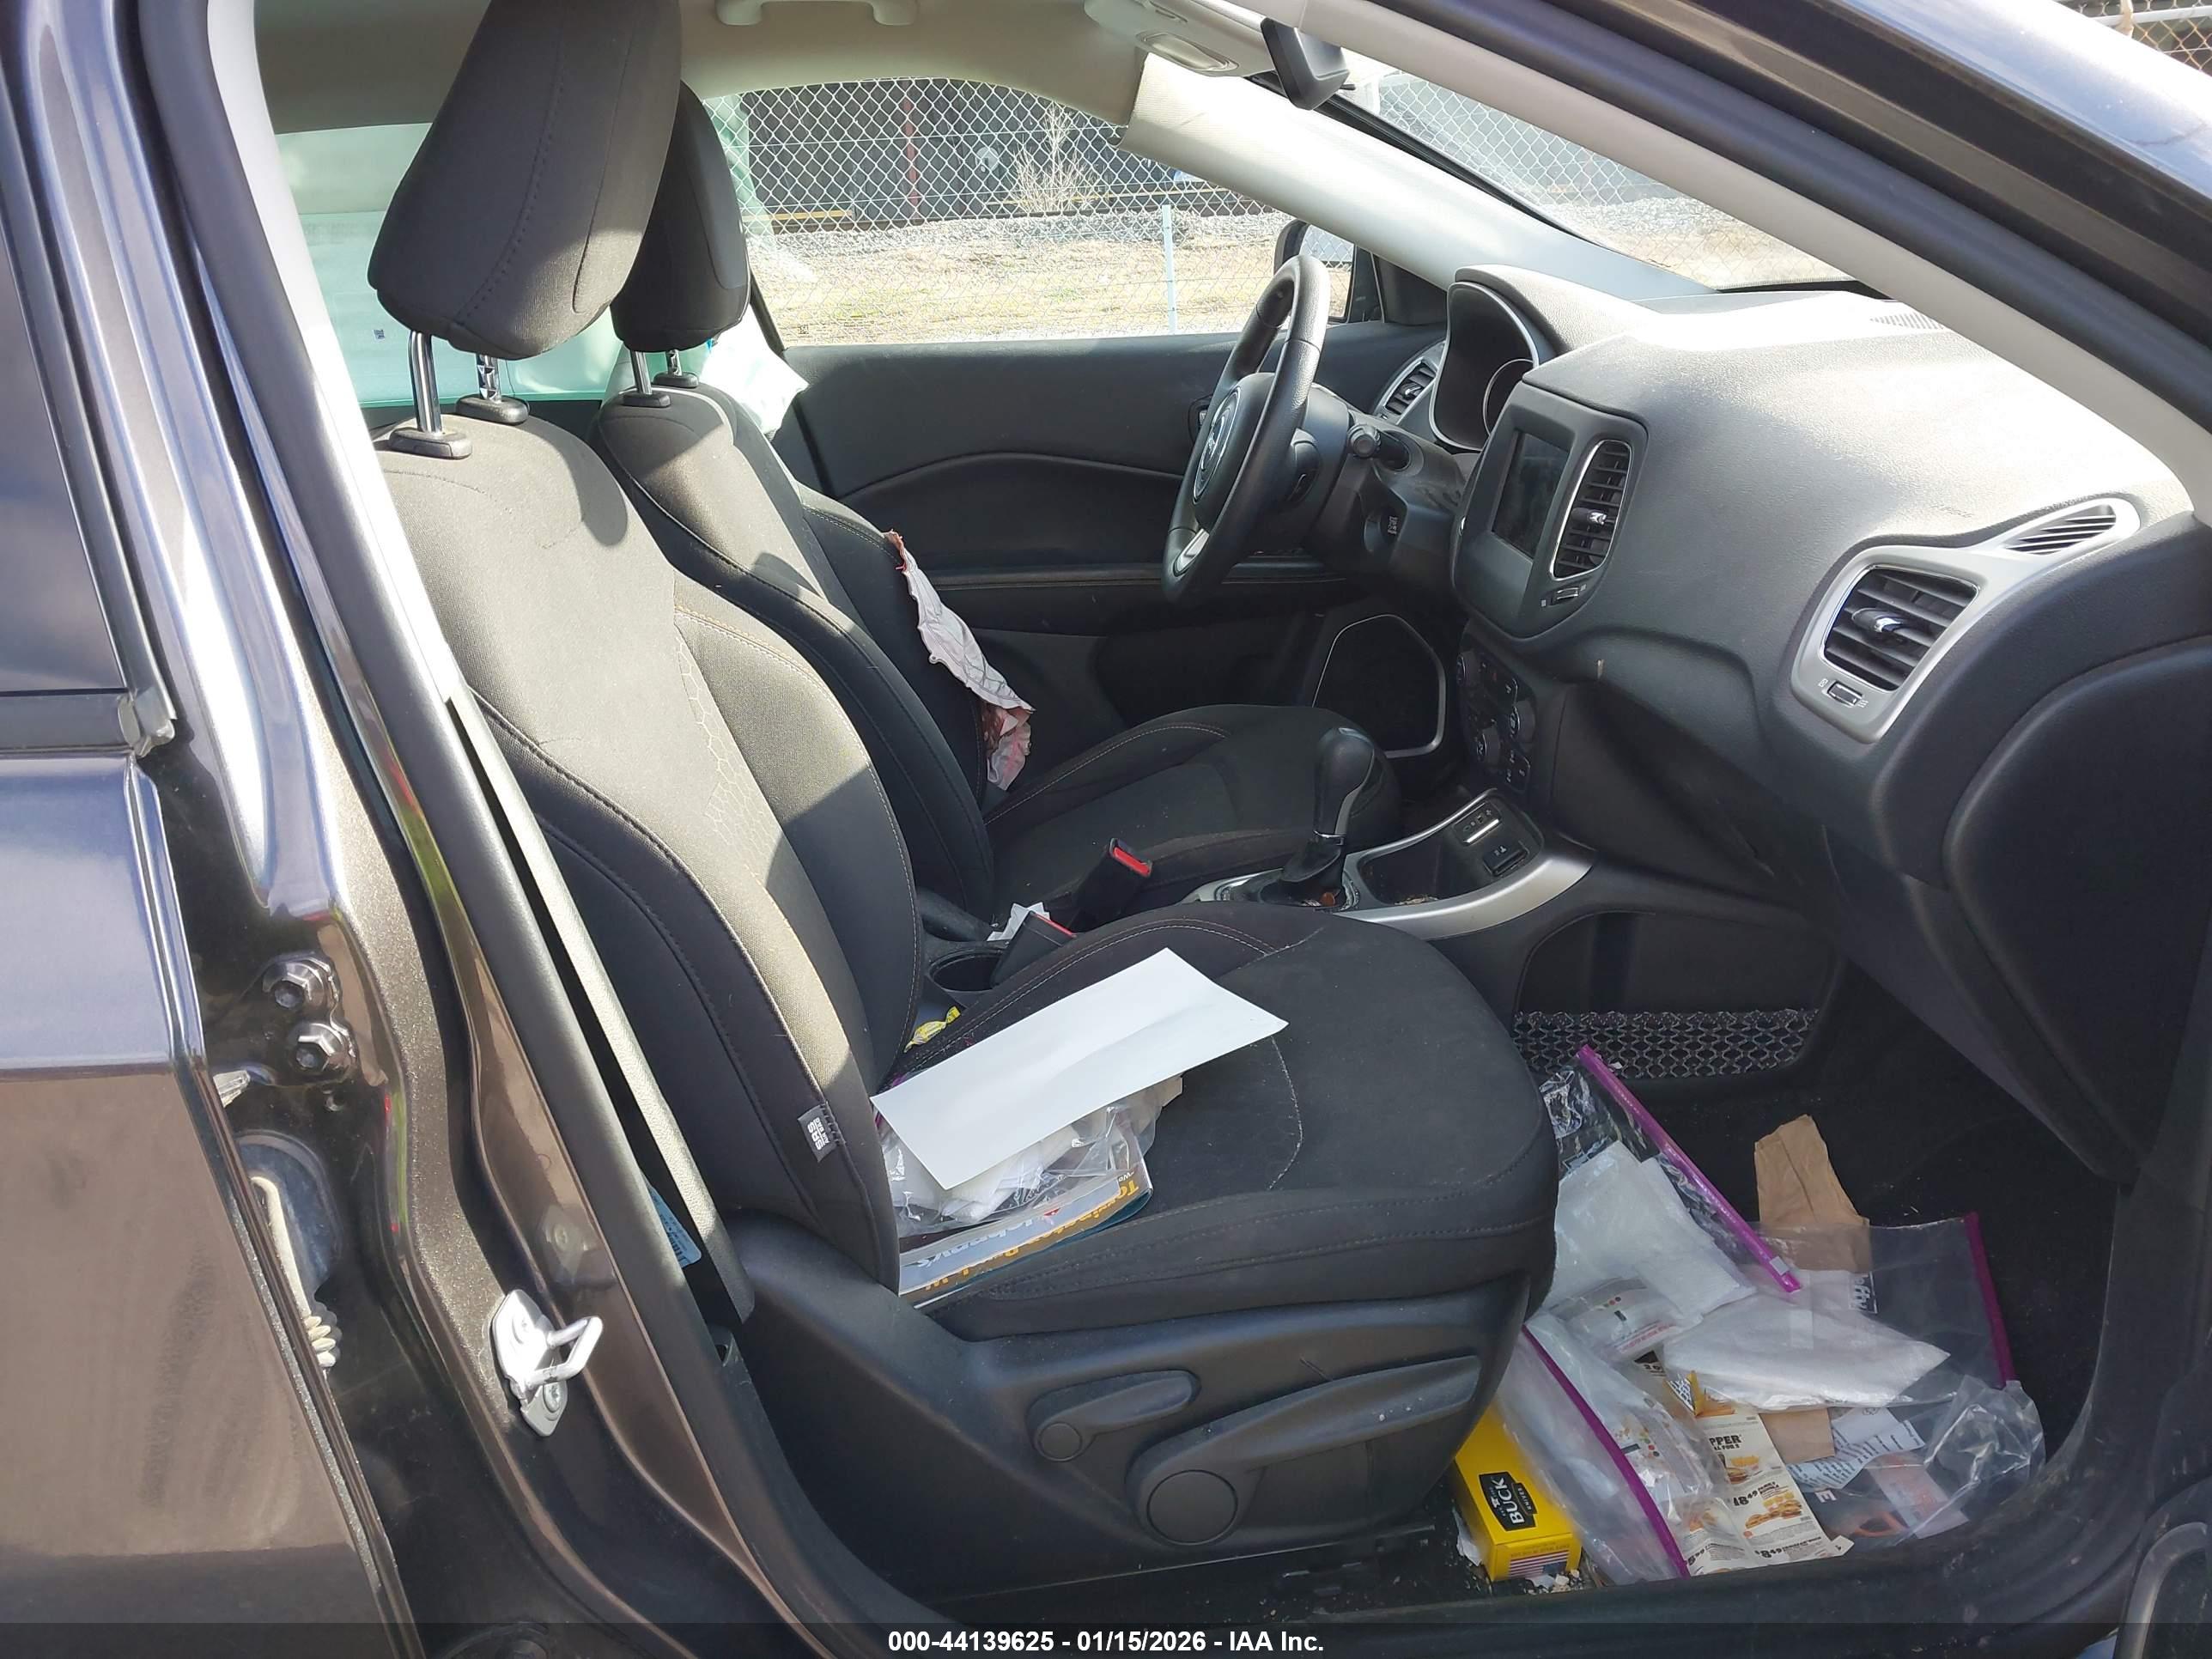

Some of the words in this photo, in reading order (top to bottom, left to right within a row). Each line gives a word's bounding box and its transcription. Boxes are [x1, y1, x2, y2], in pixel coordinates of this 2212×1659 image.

[807, 1121, 823, 1150] SRS
[815, 1117, 824, 1132] BAG
[1492, 1477, 1525, 1524] BUCK
[1517, 1487, 1532, 1510] KNIVES
